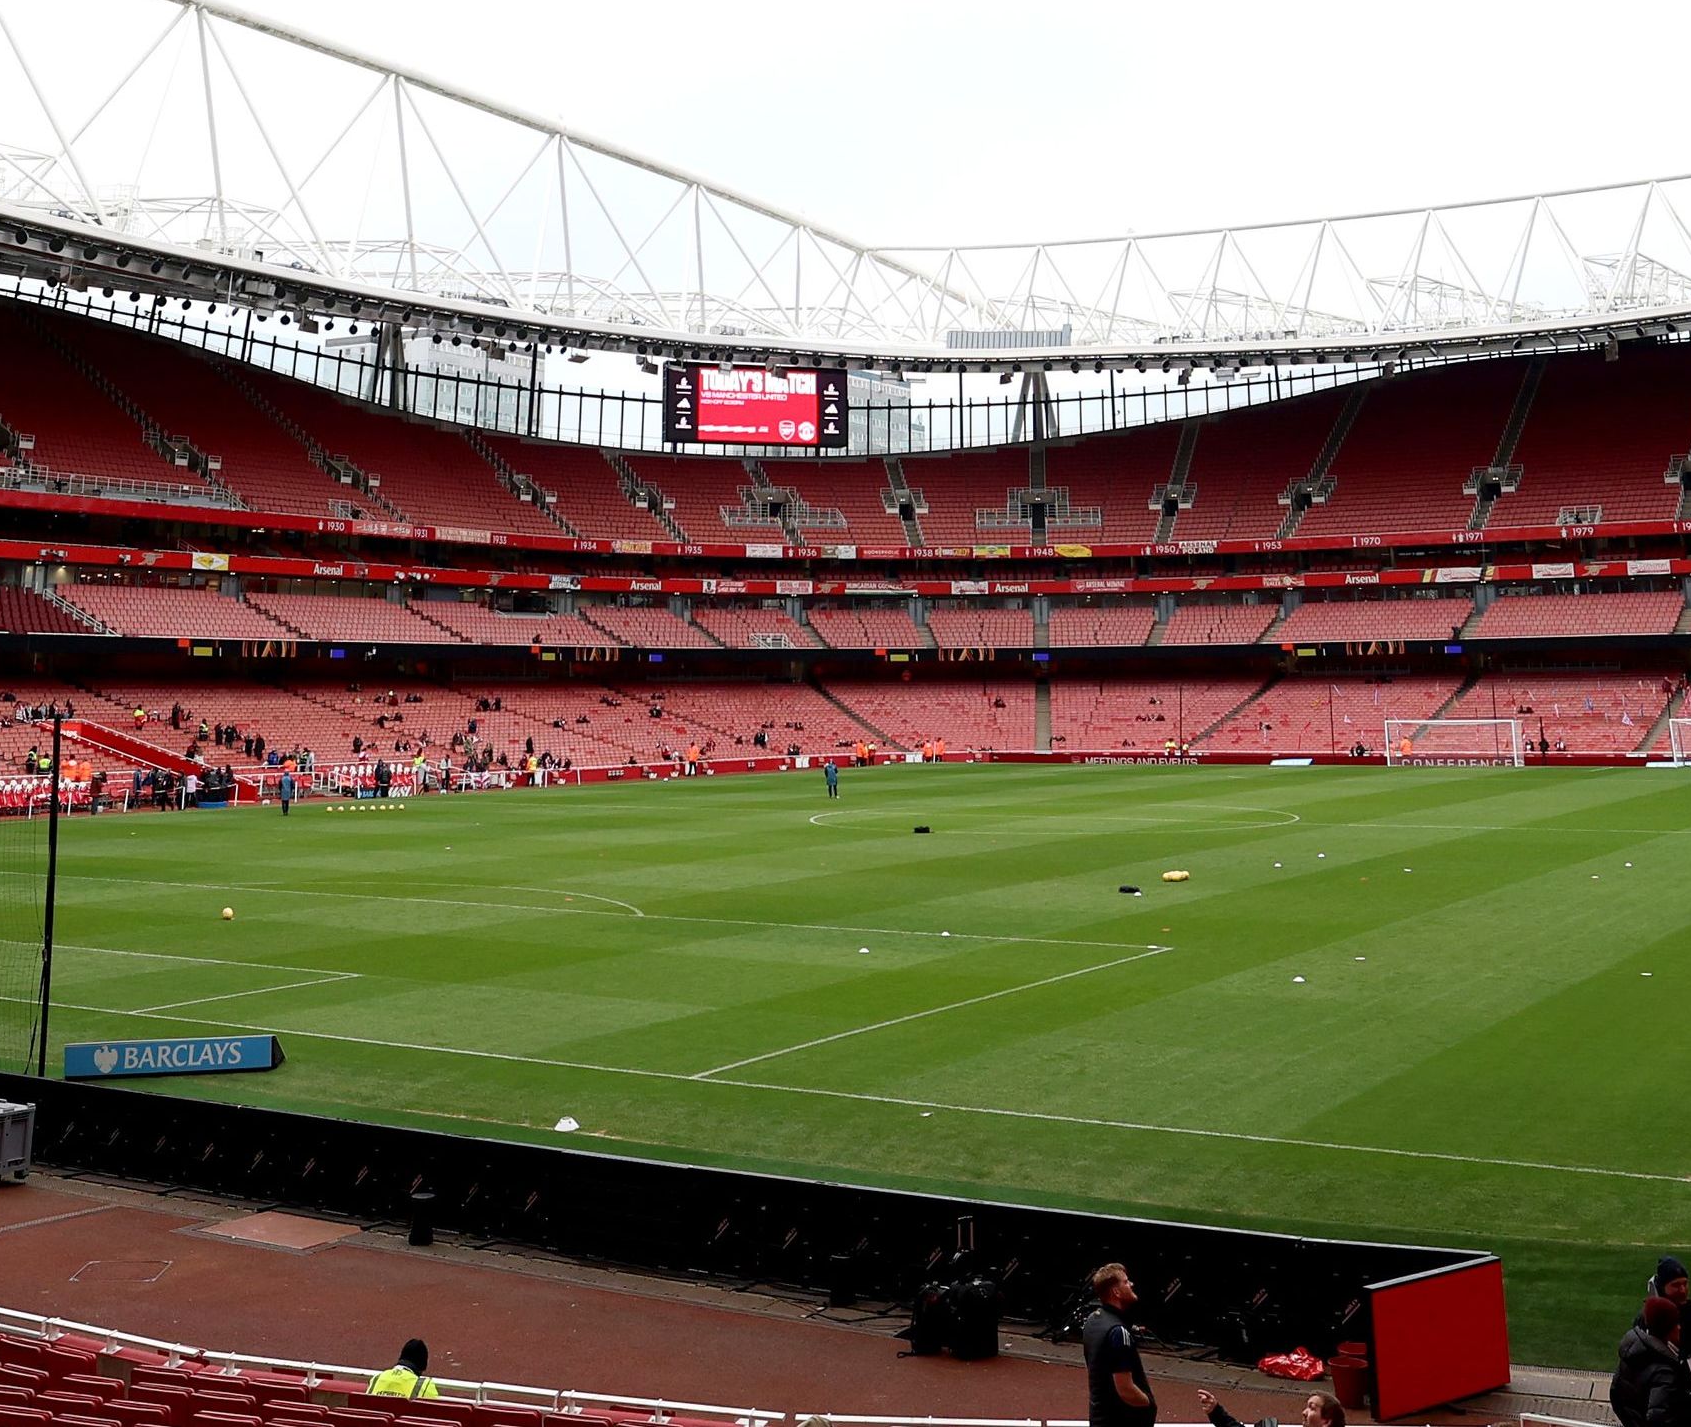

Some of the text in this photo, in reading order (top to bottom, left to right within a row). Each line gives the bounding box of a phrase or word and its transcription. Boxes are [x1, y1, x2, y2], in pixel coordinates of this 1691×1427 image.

[700, 369, 817, 395] TODAY'S MATCH
[712, 392, 762, 401] MANCHESTER
[327, 522, 345, 532] 1930
[1572, 526, 1594, 537] 1979
[414, 528, 428, 538] 1931
[1465, 532, 1483, 541] 1971
[492, 535, 507, 545] 1933
[1360, 537, 1381, 546] 1970
[580, 541, 597, 550] 1934
[685, 545, 703, 555] 1935
[1155, 545, 1176, 554] 1950
[1262, 541, 1282, 550] 1953
[798, 548, 817, 557] 1936
[913, 548, 934, 557] 1938
[1033, 548, 1054, 556] 1948
[313, 564, 343, 576] Arsenal
[1345, 575, 1380, 584] Arsenal
[630, 580, 662, 590] Arsenal
[995, 583, 1028, 593] Arsenal
[1085, 757, 1134, 765] MEETINGS
[1136, 757, 1158, 765] AND
[124, 1042, 242, 1069] BARCLAYS
